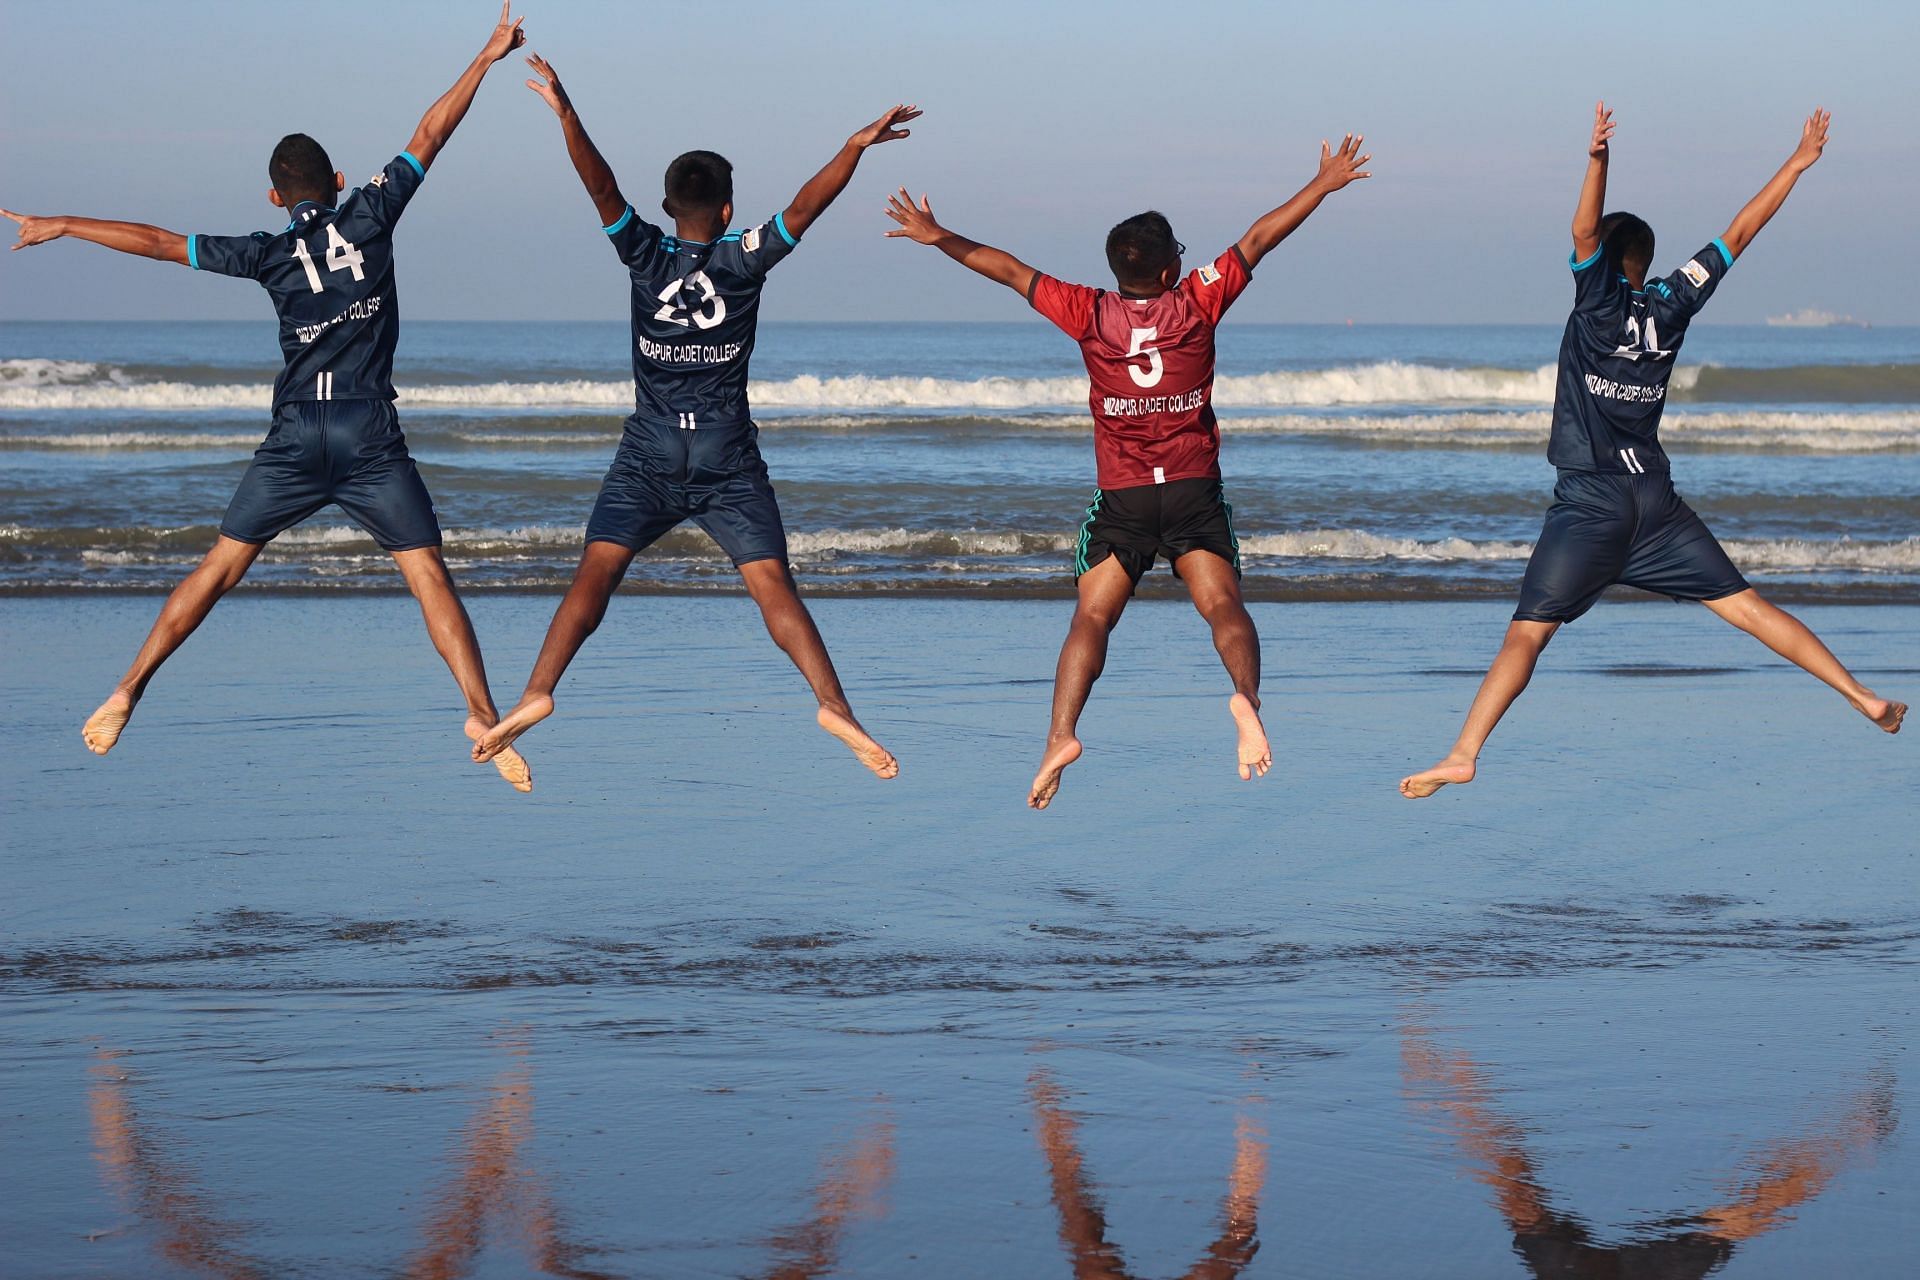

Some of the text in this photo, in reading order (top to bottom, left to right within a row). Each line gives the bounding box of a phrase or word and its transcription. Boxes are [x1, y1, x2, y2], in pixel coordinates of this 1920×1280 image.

[291, 222, 365, 294] 14
[654, 270, 726, 330] 23
[673, 344, 701, 362] CADET
[1125, 326, 1164, 388] 5
[1138, 396, 1167, 415] CADET
[1168, 388, 1204, 412] COLLEGE
